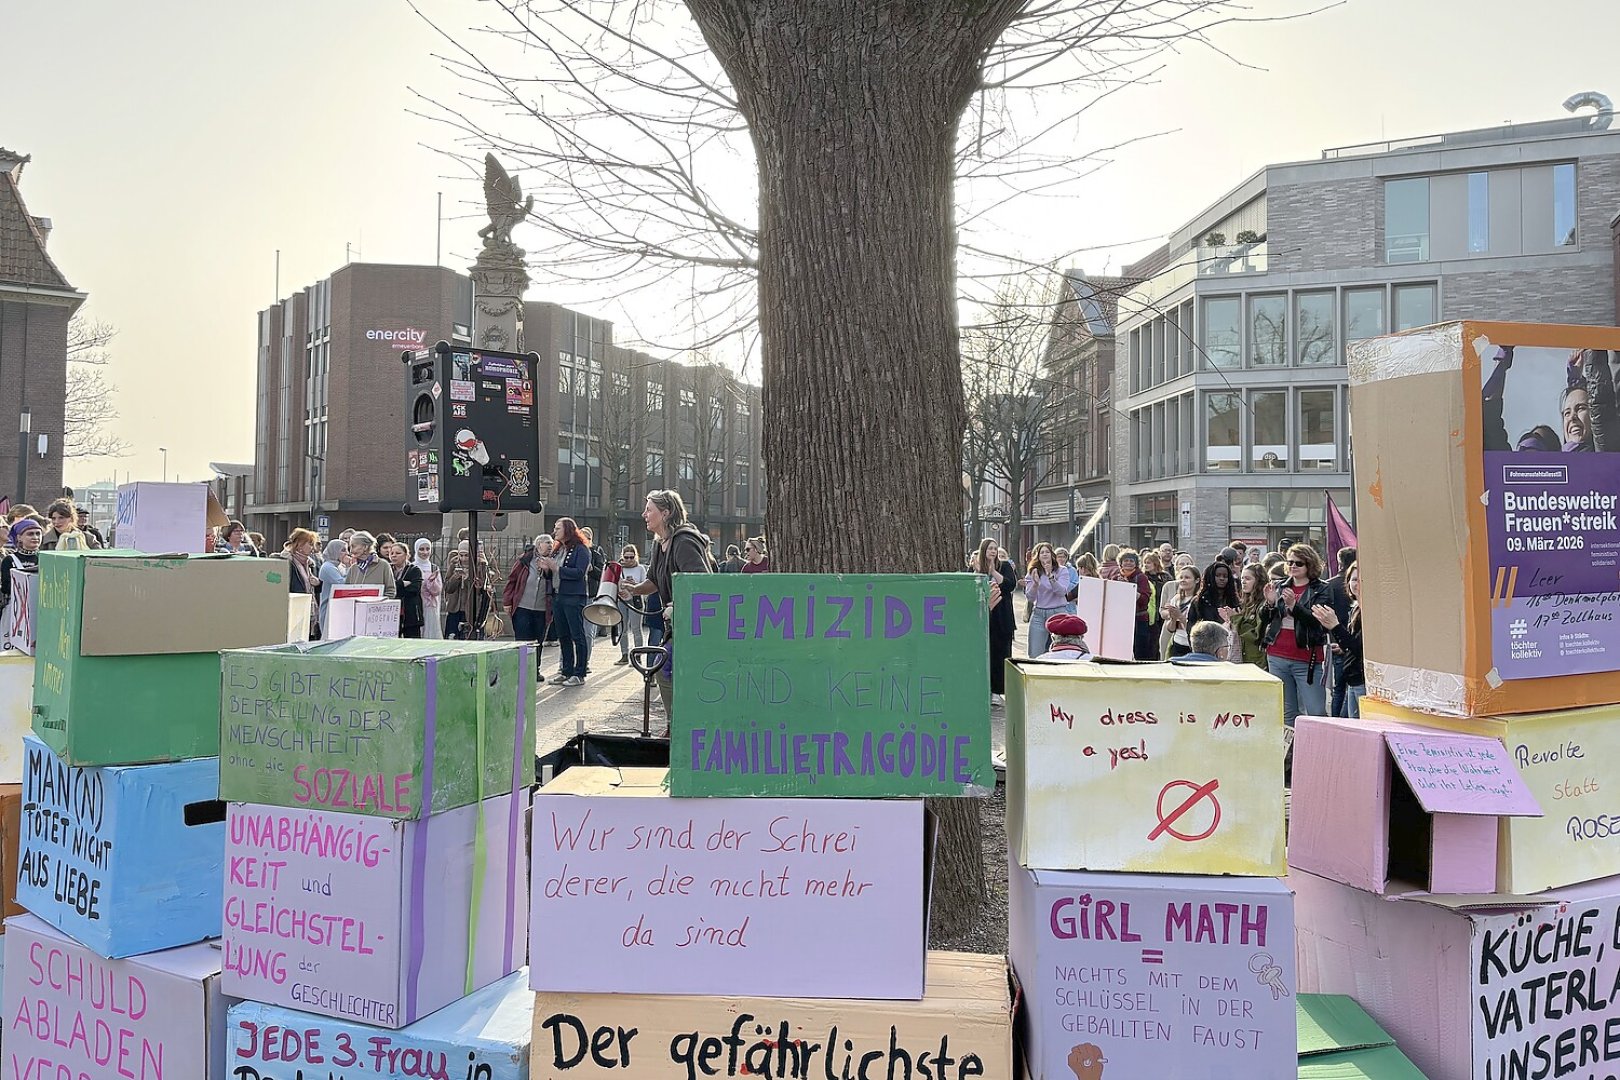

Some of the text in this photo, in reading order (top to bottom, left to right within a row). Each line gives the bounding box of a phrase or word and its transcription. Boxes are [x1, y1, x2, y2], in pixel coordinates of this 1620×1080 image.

[366, 328, 425, 343] enercity
[1264, 452, 1276, 461] dsp
[1504, 490, 1618, 511] Bundesweiter
[1506, 535, 1584, 551] 09. März 2026
[1528, 567, 1565, 588] Leer
[1561, 609, 1613, 625] Zollhaus
[1510, 641, 1538, 650] töchter
[1511, 649, 1543, 660] kollektiv
[230, 664, 259, 690] ES
[349, 709, 395, 733] DER
[1049, 702, 1256, 730] My dress is NOT
[228, 755, 285, 772] ohne die
[1082, 738, 1149, 770] a yes!
[1443, 763, 1459, 776] die
[1459, 762, 1502, 776] Wahrheit
[1478, 748, 1497, 761] jede
[1514, 741, 1585, 770] Revolte
[27, 749, 105, 834] MAN(N)
[293, 763, 413, 814] SOZIALE
[1439, 779, 1457, 790] ihr
[23, 802, 112, 871] TÖTET NICHT
[551, 808, 861, 854] Wir sind der Schrei
[18, 846, 101, 920] AUS LIEBE
[301, 872, 332, 897] und
[544, 863, 874, 901] derer, die nicht mehr
[621, 913, 750, 948] da sind
[1164, 901, 1268, 947] MATH
[1479, 908, 1605, 985] KÜCHE,
[224, 940, 321, 985] LUNG der
[28, 941, 147, 1021] SCHULD
[1055, 965, 1128, 986] NACHTS
[1199, 975, 1239, 993] DEM
[291, 982, 395, 1024] GESCHLECHTER
[1054, 987, 1160, 1013] SCHLÜSSEL
[1217, 999, 1254, 1019] DER
[13, 995, 163, 1080] ABLADEN
[542, 1013, 985, 1080] Der gefährlichste
[1061, 1013, 1264, 1050] GEBALLTEN FAUST
[236, 1021, 493, 1080] JEDE 3. Frau in
